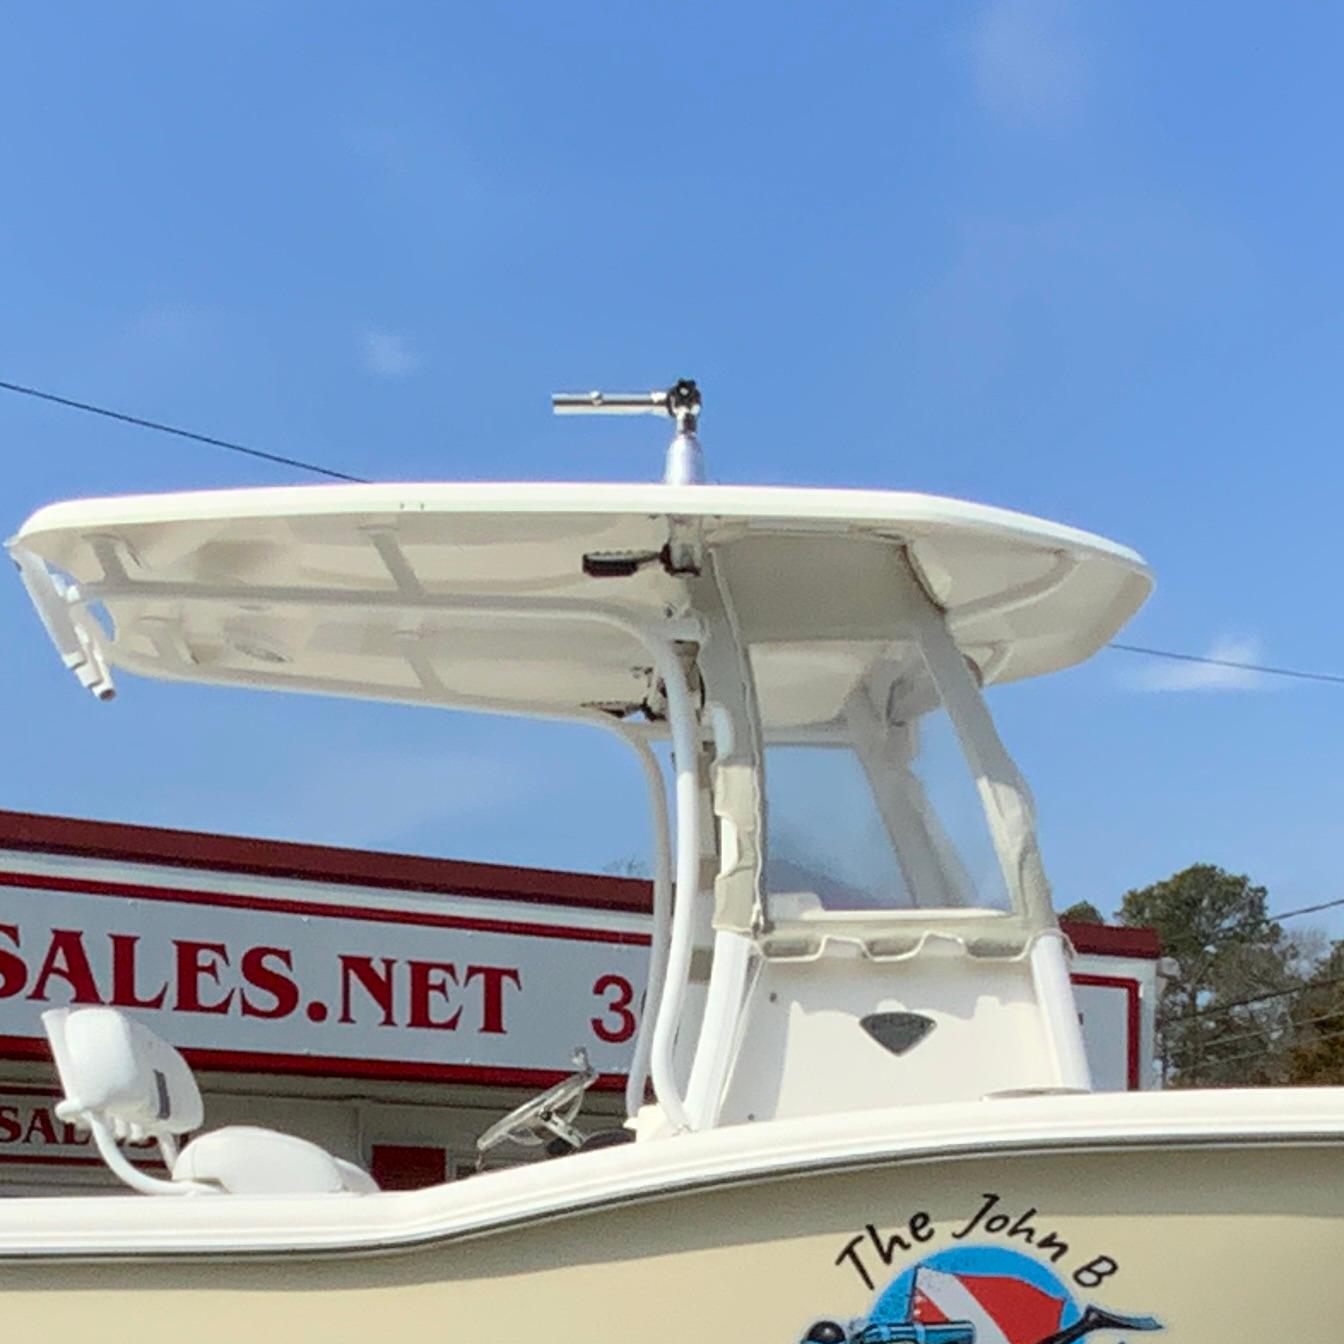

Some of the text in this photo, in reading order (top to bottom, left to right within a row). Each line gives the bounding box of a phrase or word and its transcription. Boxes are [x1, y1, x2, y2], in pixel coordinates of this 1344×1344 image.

[835, 1192, 1119, 1291] The John B
